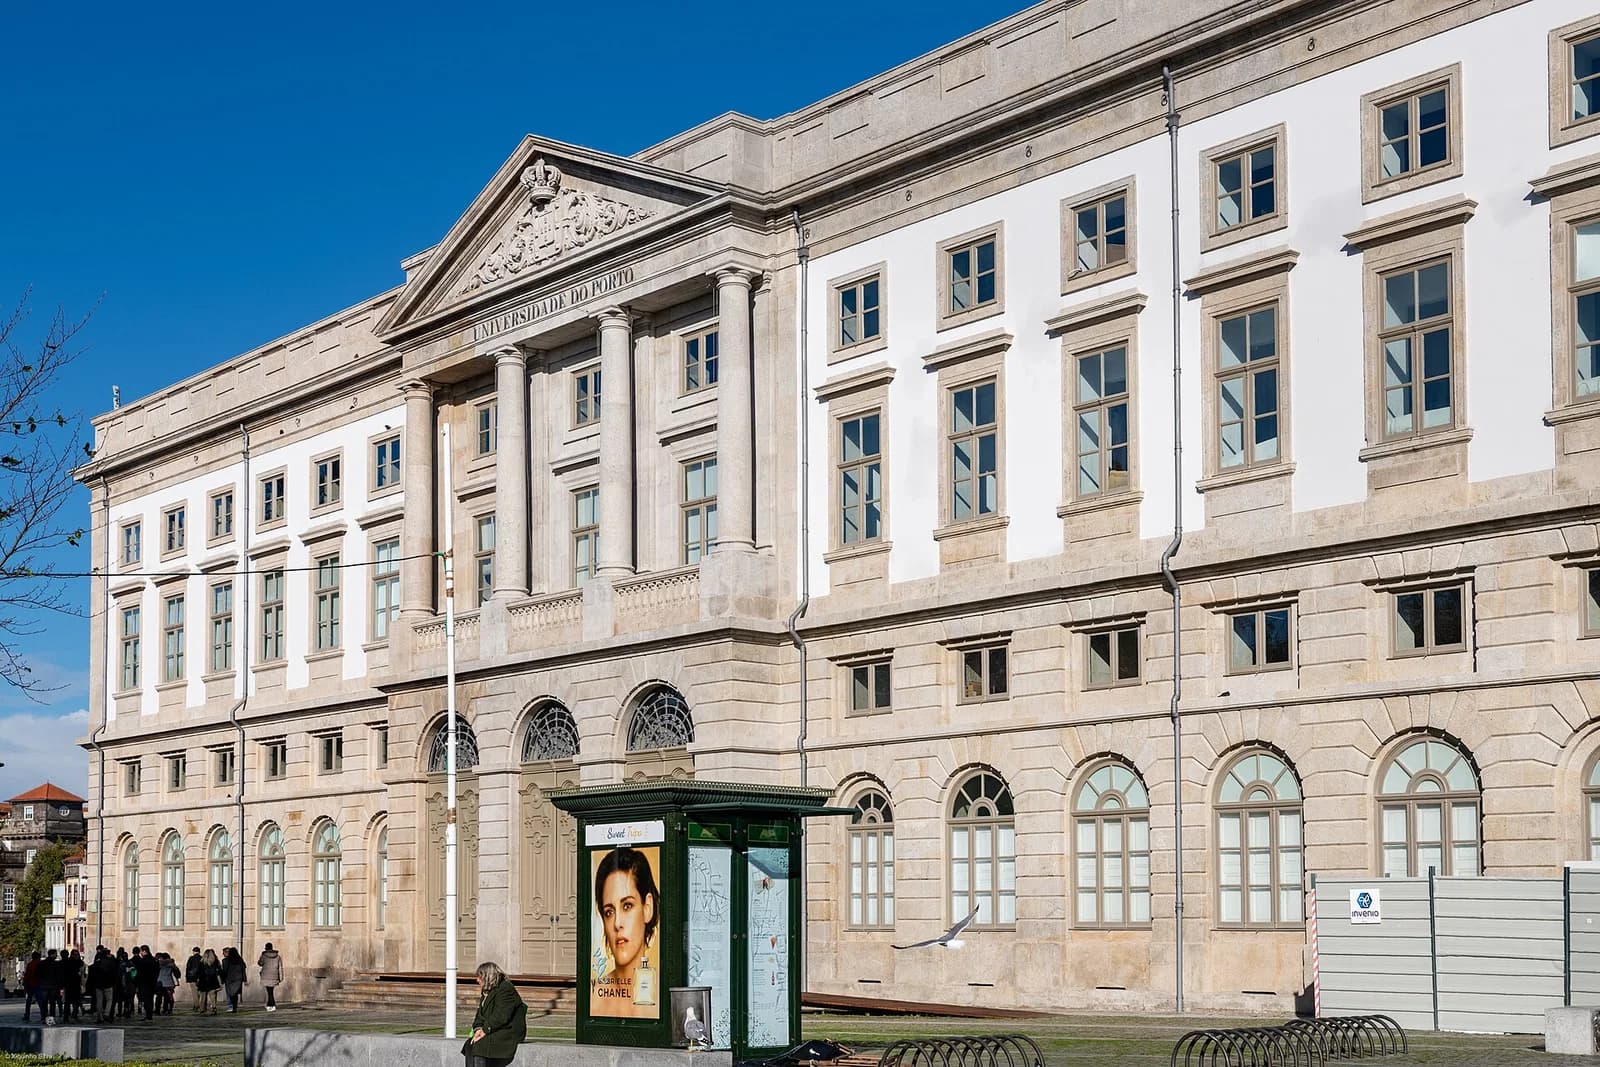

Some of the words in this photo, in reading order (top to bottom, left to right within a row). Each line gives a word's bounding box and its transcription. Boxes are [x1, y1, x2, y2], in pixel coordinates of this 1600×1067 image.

[472, 293, 567, 341] UNIVERSIDADE
[570, 287, 589, 304] DO
[591, 266, 634, 296] PORTO
[607, 827, 626, 840] Sweet
[597, 988, 632, 998] CHANEL
